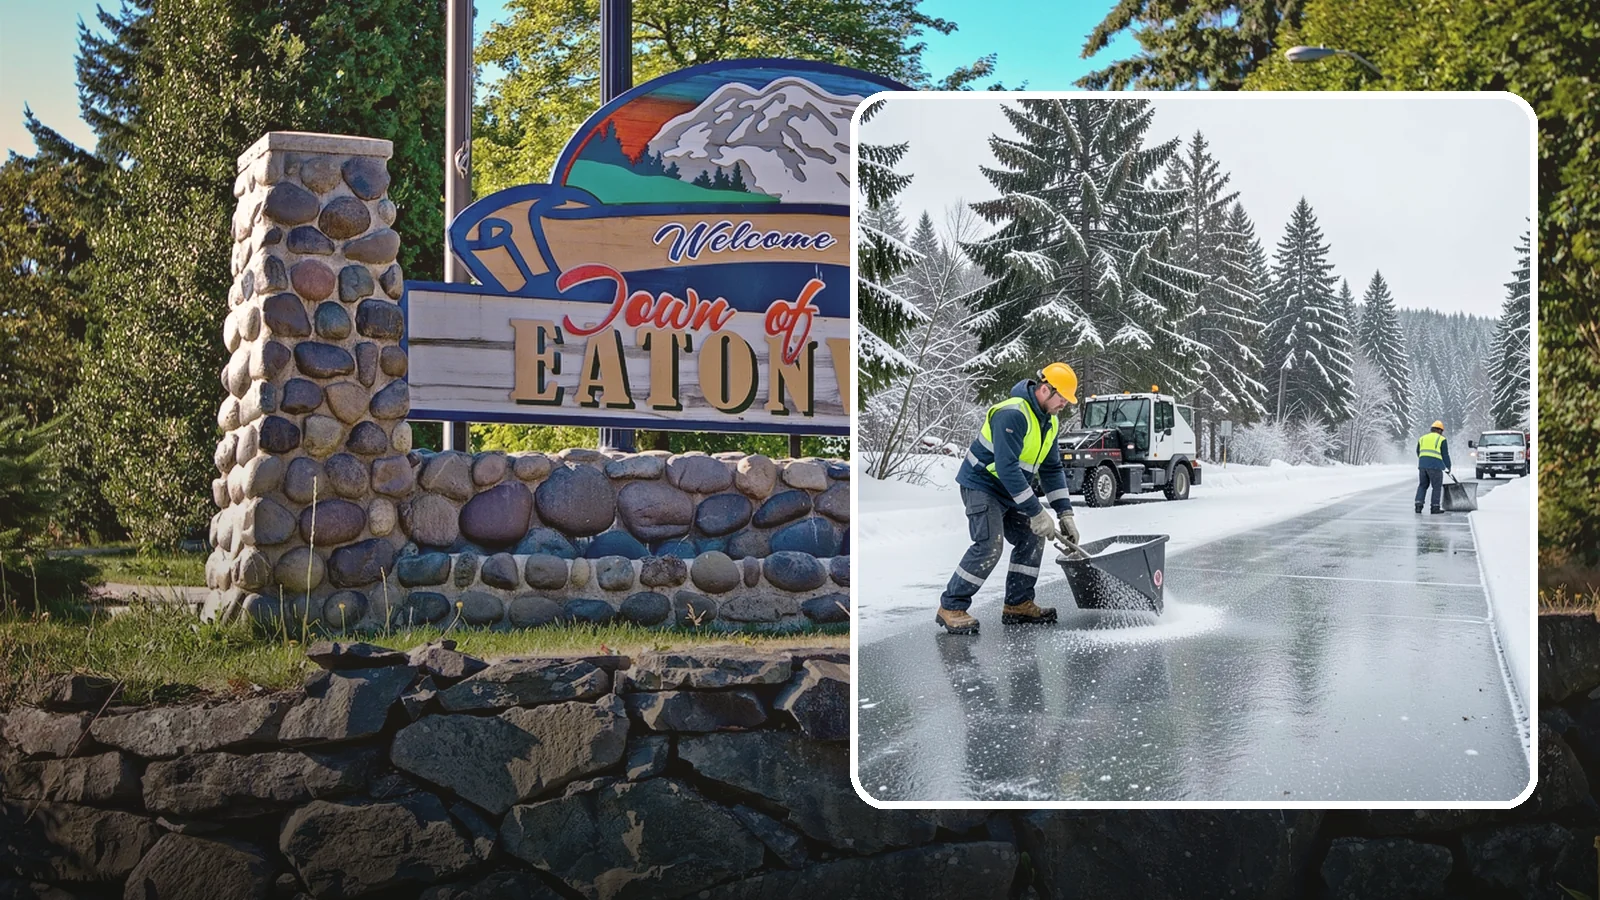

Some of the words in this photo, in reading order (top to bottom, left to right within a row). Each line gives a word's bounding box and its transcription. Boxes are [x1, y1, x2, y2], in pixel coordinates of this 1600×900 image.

[653, 220, 836, 263] Welcome
[557, 264, 737, 336] Town
[764, 278, 826, 365] of
